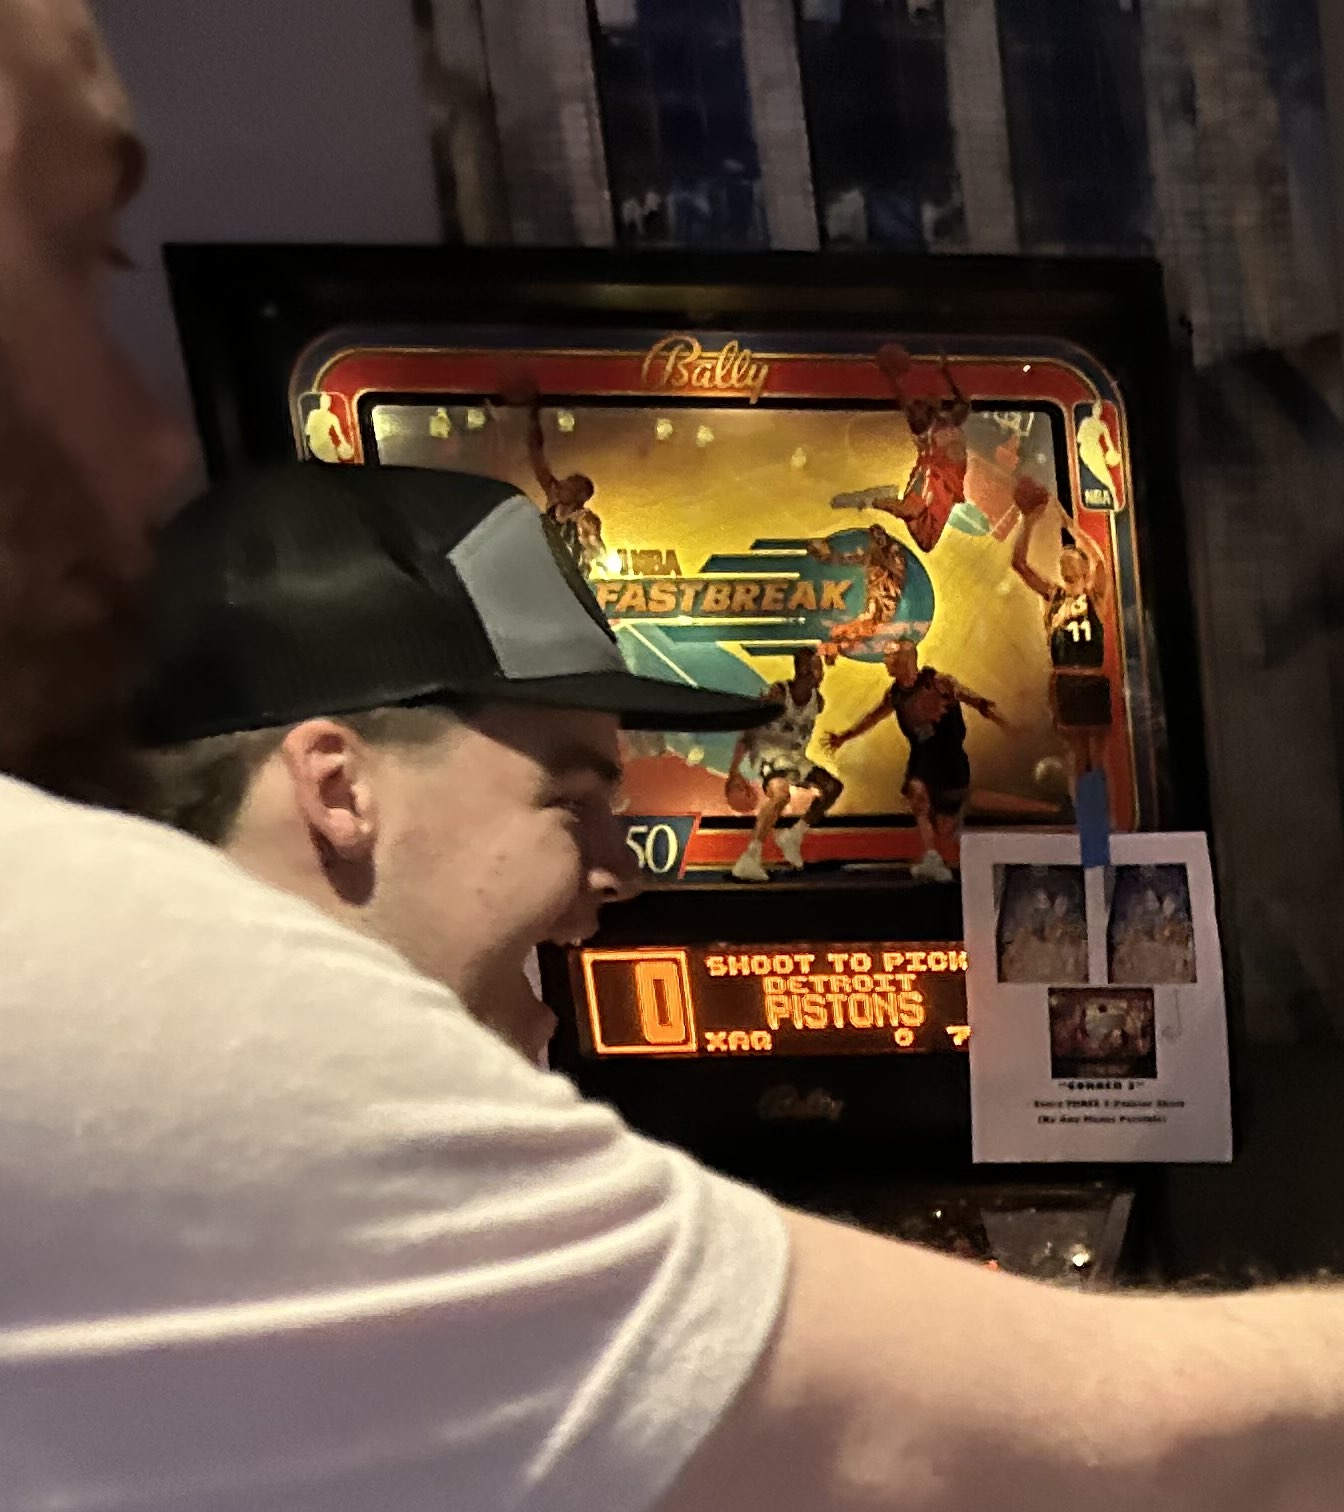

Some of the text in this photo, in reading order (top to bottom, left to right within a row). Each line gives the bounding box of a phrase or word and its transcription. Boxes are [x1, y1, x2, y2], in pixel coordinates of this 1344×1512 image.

[641, 331, 768, 404] Bally
[595, 580, 854, 614] FASTBREAK
[626, 824, 678, 874] 50
[706, 950, 968, 976] SHOOT TO PICK
[762, 974, 917, 995] DETROIT
[763, 991, 926, 1031] PISTONS
